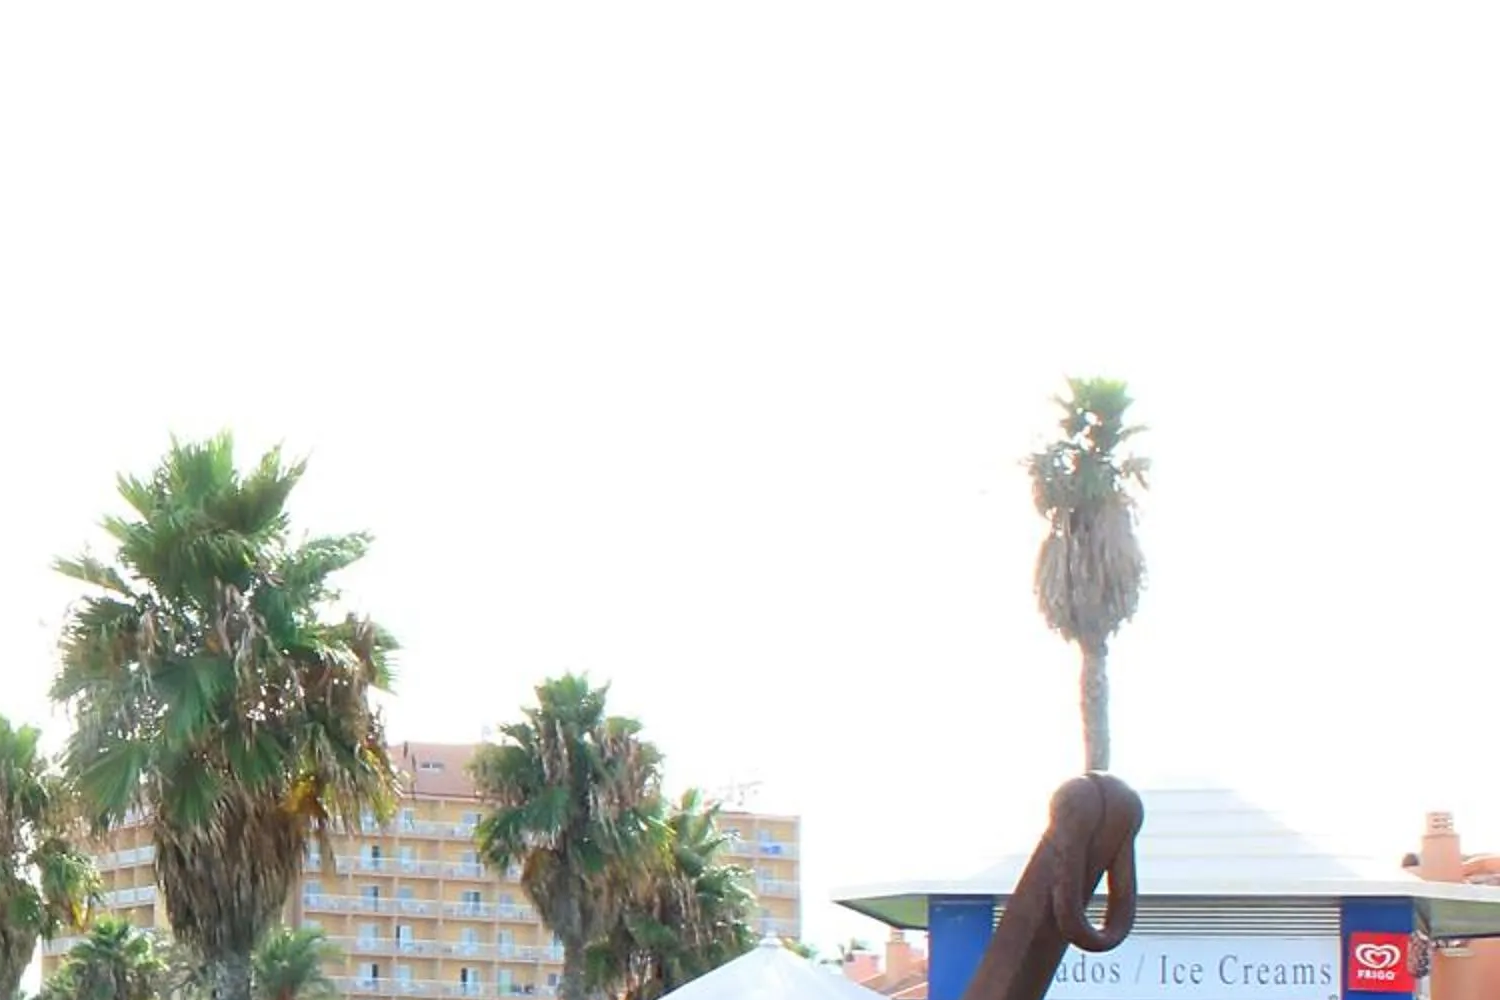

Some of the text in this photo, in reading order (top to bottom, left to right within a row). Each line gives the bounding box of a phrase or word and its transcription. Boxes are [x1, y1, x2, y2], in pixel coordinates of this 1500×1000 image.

[1160, 954, 1204, 985] Ice
[1219, 953, 1333, 986] Creams
[1357, 968, 1396, 981] FRIGO
